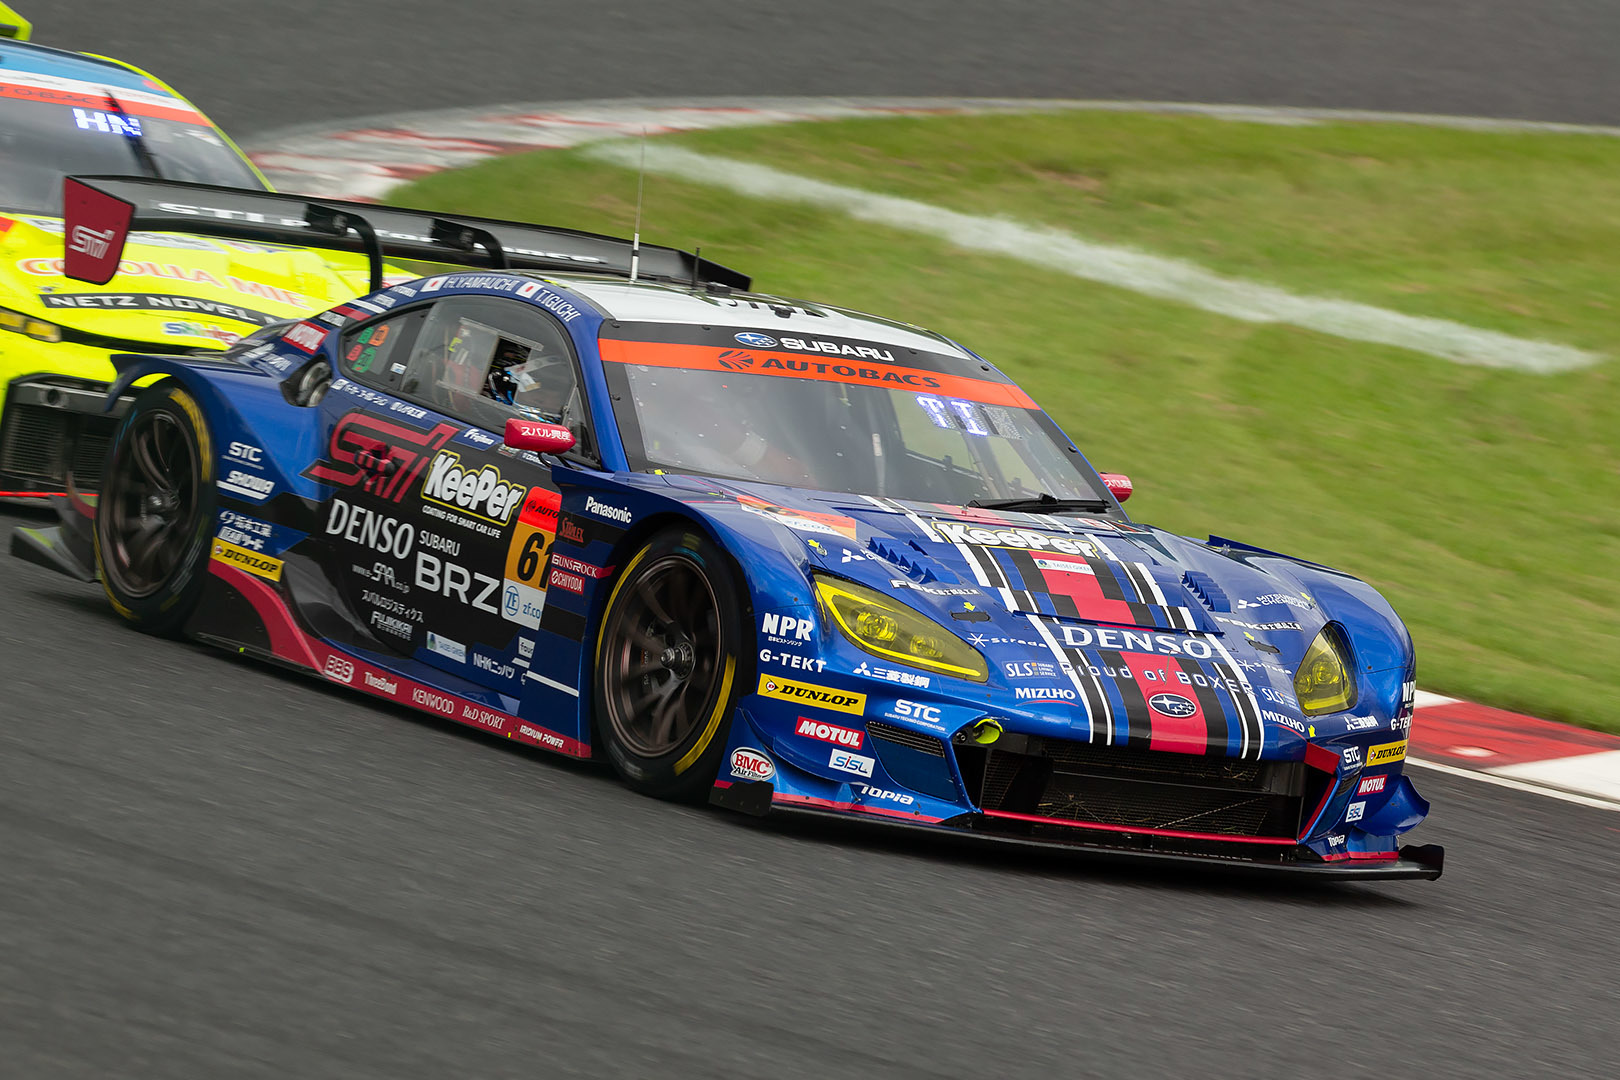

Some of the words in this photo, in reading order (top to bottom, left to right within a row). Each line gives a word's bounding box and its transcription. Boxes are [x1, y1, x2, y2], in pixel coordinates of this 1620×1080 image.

[50, 296, 139, 308] NETZ
[149, 297, 258, 322] NOVEL
[780, 337, 896, 362] SUBARU
[762, 357, 941, 388] AUTOBACS
[229, 441, 263, 463] STC
[422, 453, 523, 521] KeePer
[585, 496, 632, 524] Panasonic
[325, 498, 415, 560] DENSO
[446, 512, 457, 524] FOR
[456, 516, 475, 531] SMART
[476, 522, 488, 535] CAR
[488, 525, 502, 539] LIFE
[419, 529, 460, 557] SUBARU
[941, 523, 1099, 557] KeePer
[223, 548, 279, 573] DUNLOP
[415, 550, 500, 615] BRZ
[558, 572, 583, 592] CHIYODA
[761, 612, 814, 641] NPR
[1060, 626, 1212, 660] DENSO
[325, 654, 355, 684] BBS
[759, 649, 827, 673] G-TEKT
[1005, 662, 1034, 677] SLS
[1059, 660, 1133, 679] Proud
[1144, 669, 1168, 683] of
[1178, 670, 1258, 697] BOXER
[412, 687, 455, 714] KENWOOD
[779, 684, 859, 708] DUNLOP
[1015, 687, 1076, 700] MIZUHO
[1261, 687, 1284, 705] SLS
[462, 705, 480, 722] R&D
[480, 711, 506, 731] SPORT
[894, 699, 942, 723] STC
[1261, 709, 1306, 733] MIZUHO
[520, 725, 543, 741] IRIDIUM
[543, 733, 565, 748] POWER
[799, 719, 861, 747] MOTUL
[734, 754, 770, 775] BMC
[1343, 746, 1361, 764] STC
[733, 767, 747, 777] Air
[1359, 777, 1385, 794] MOTUL
